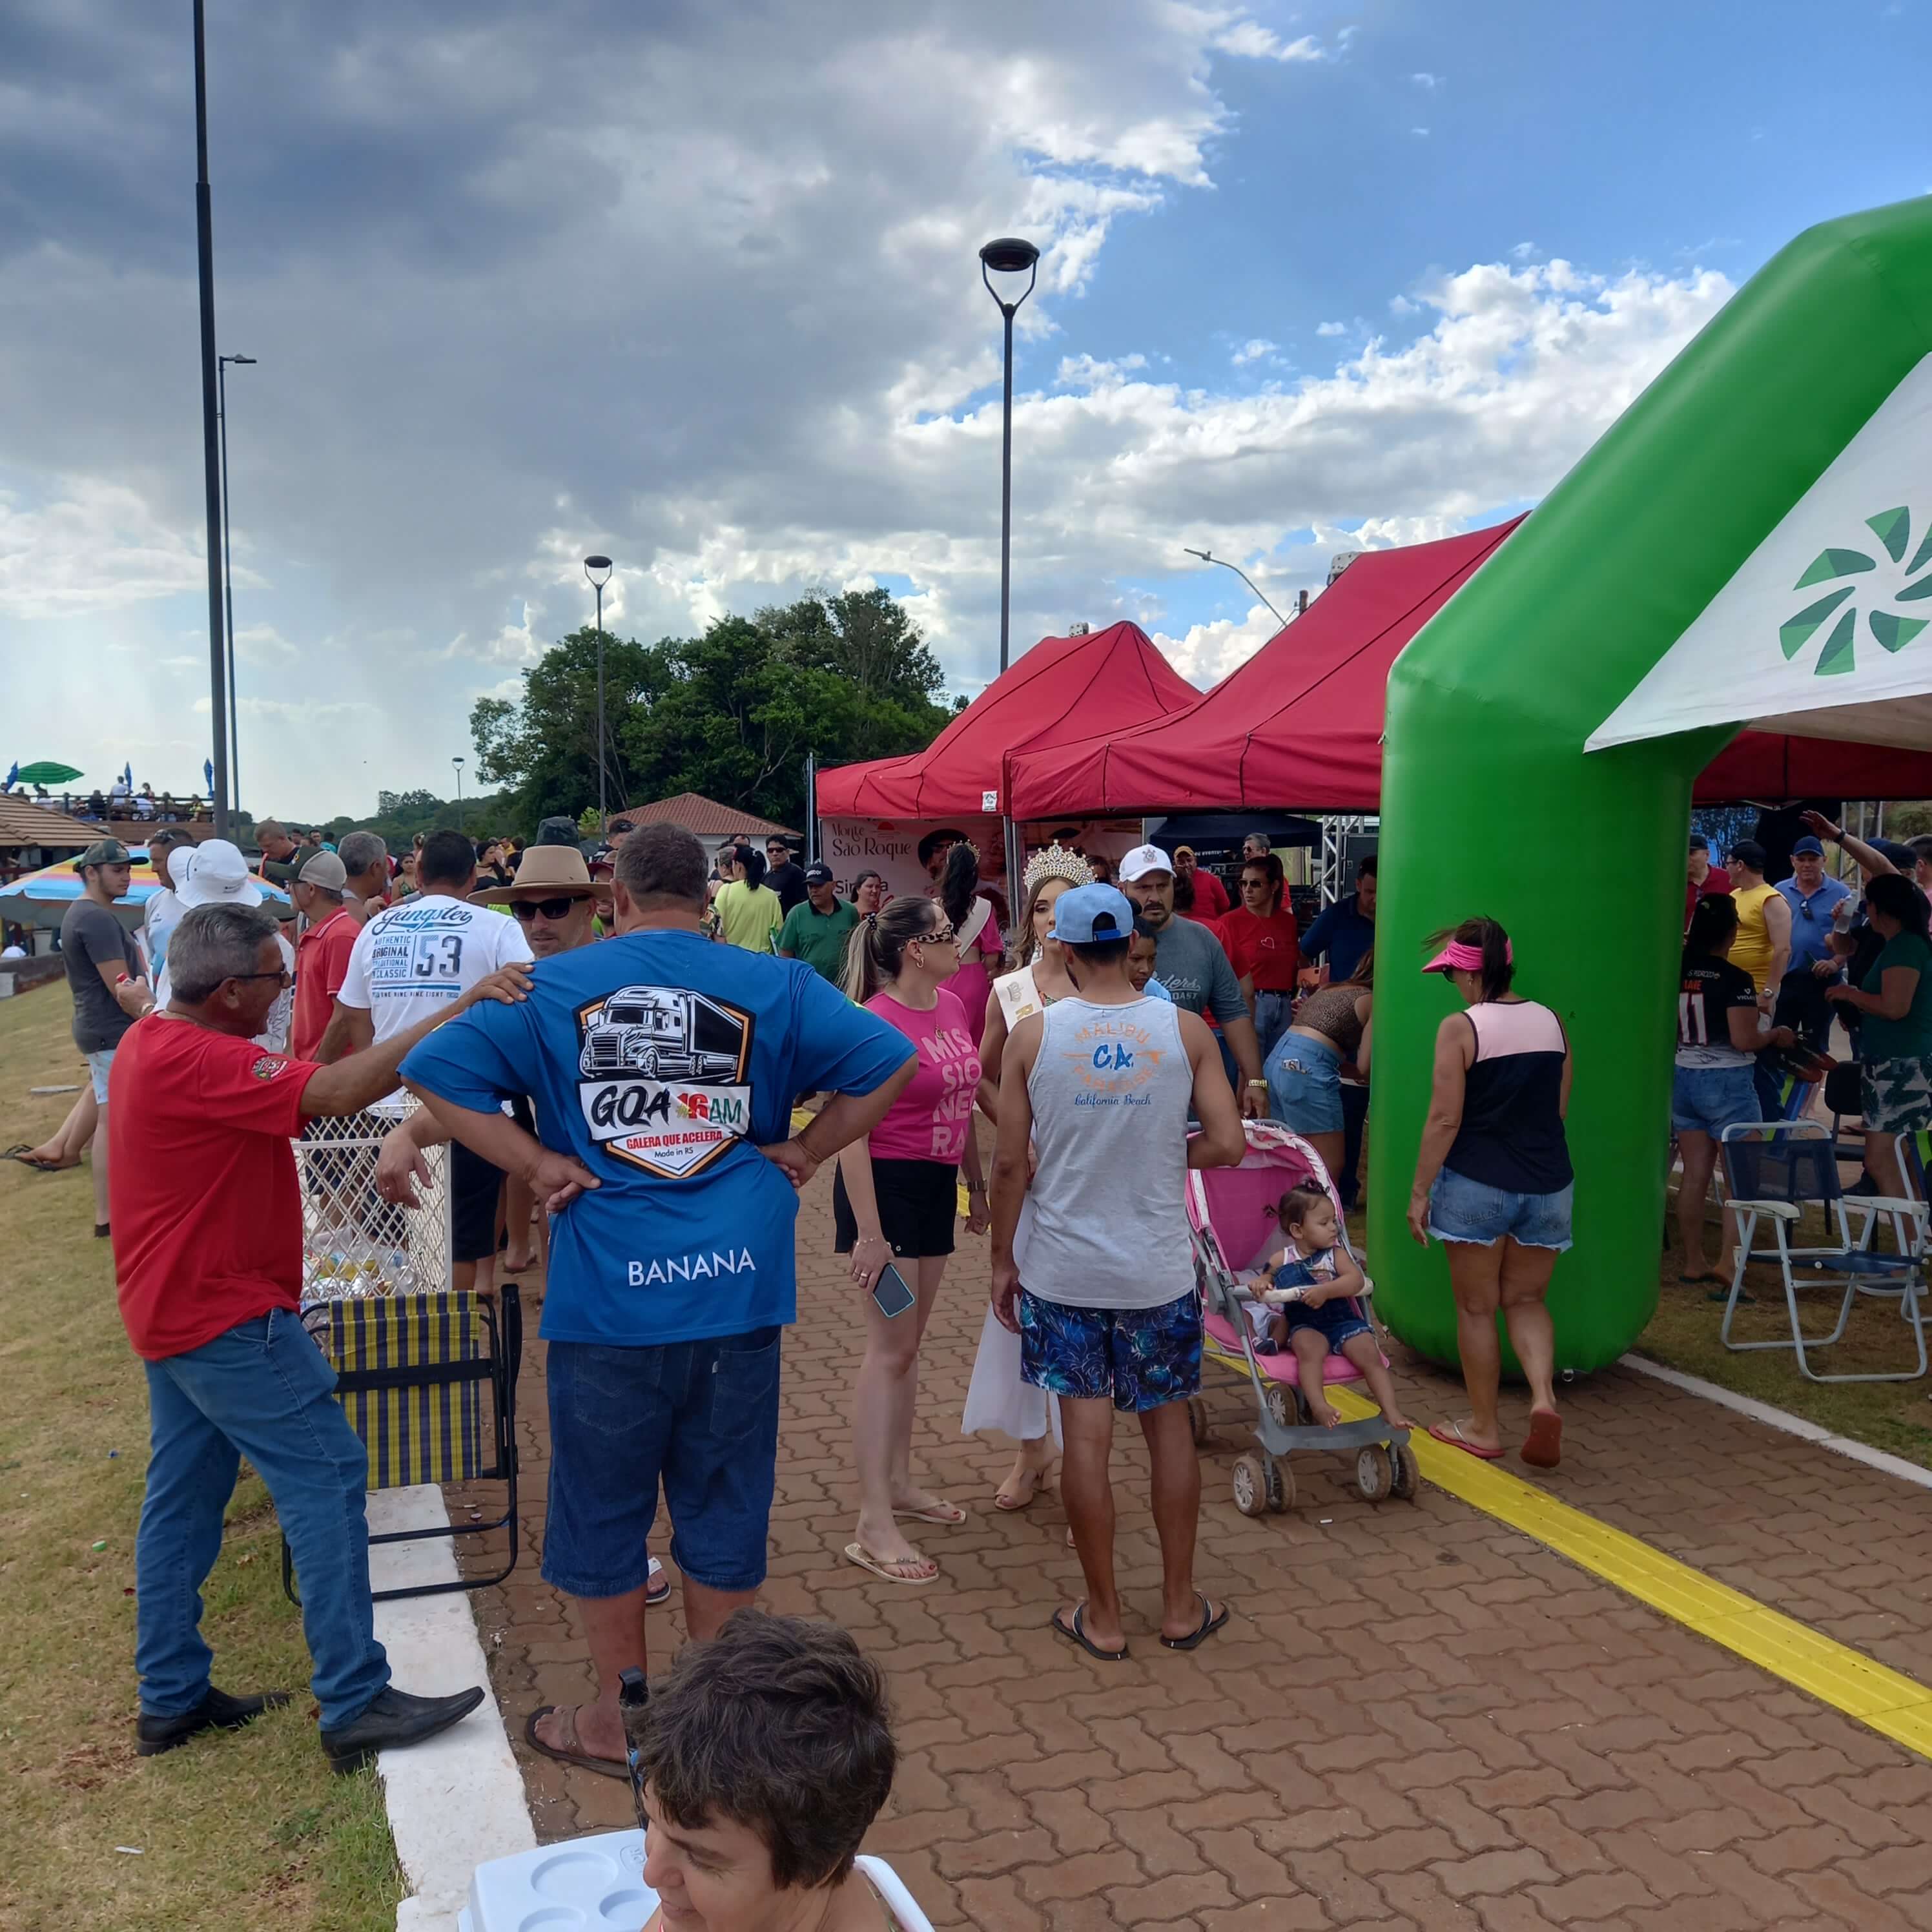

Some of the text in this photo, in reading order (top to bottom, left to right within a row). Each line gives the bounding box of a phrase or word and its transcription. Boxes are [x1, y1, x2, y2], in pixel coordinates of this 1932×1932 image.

[832, 823, 864, 841] Monte
[832, 838, 911, 861] São Roque
[372, 905, 473, 936] Gangster
[372, 946, 409, 959] ORIGINAL
[374, 936, 411, 946] AUTHENTIC
[415, 935, 463, 978] 53
[921, 1027, 973, 1064] MIS
[941, 1056, 983, 1095] SIO
[590, 1085, 672, 1130] GQA
[1074, 1093, 1152, 1108] California Beach
[626, 1130, 724, 1150] GALERA QUE ACELERA
[930, 1125, 966, 1157] RA
[654, 1150, 675, 1158] Made
[628, 1247, 757, 1287] BANANA
